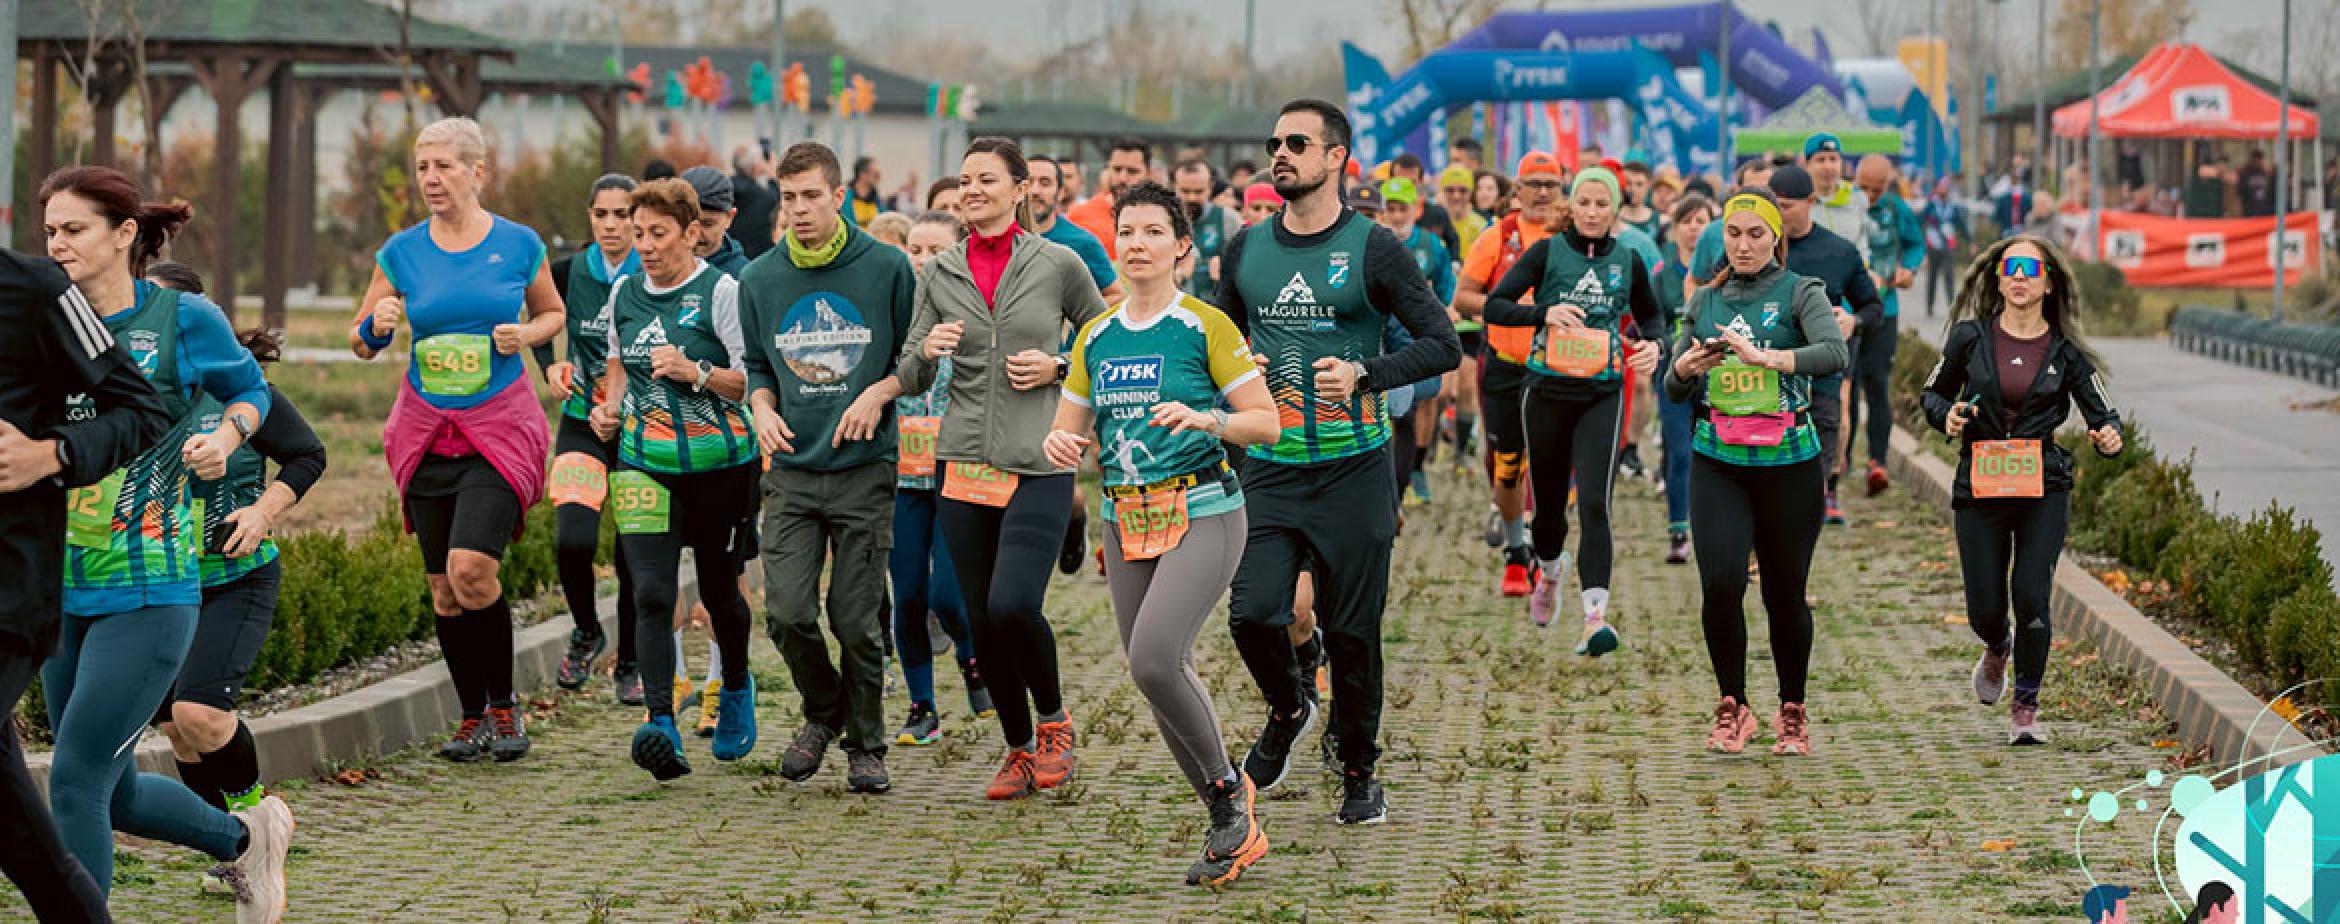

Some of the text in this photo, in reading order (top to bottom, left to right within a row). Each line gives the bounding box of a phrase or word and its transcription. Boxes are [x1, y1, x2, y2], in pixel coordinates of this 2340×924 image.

[1555, 339, 1601, 359] 1152
[1108, 363, 1158, 382] JYSK
[1720, 370, 1766, 393] 901
[1095, 390, 1161, 407] RUNNING
[1111, 405, 1145, 419] CLUB
[901, 433, 937, 455] 101
[1976, 453, 2037, 476] 1069
